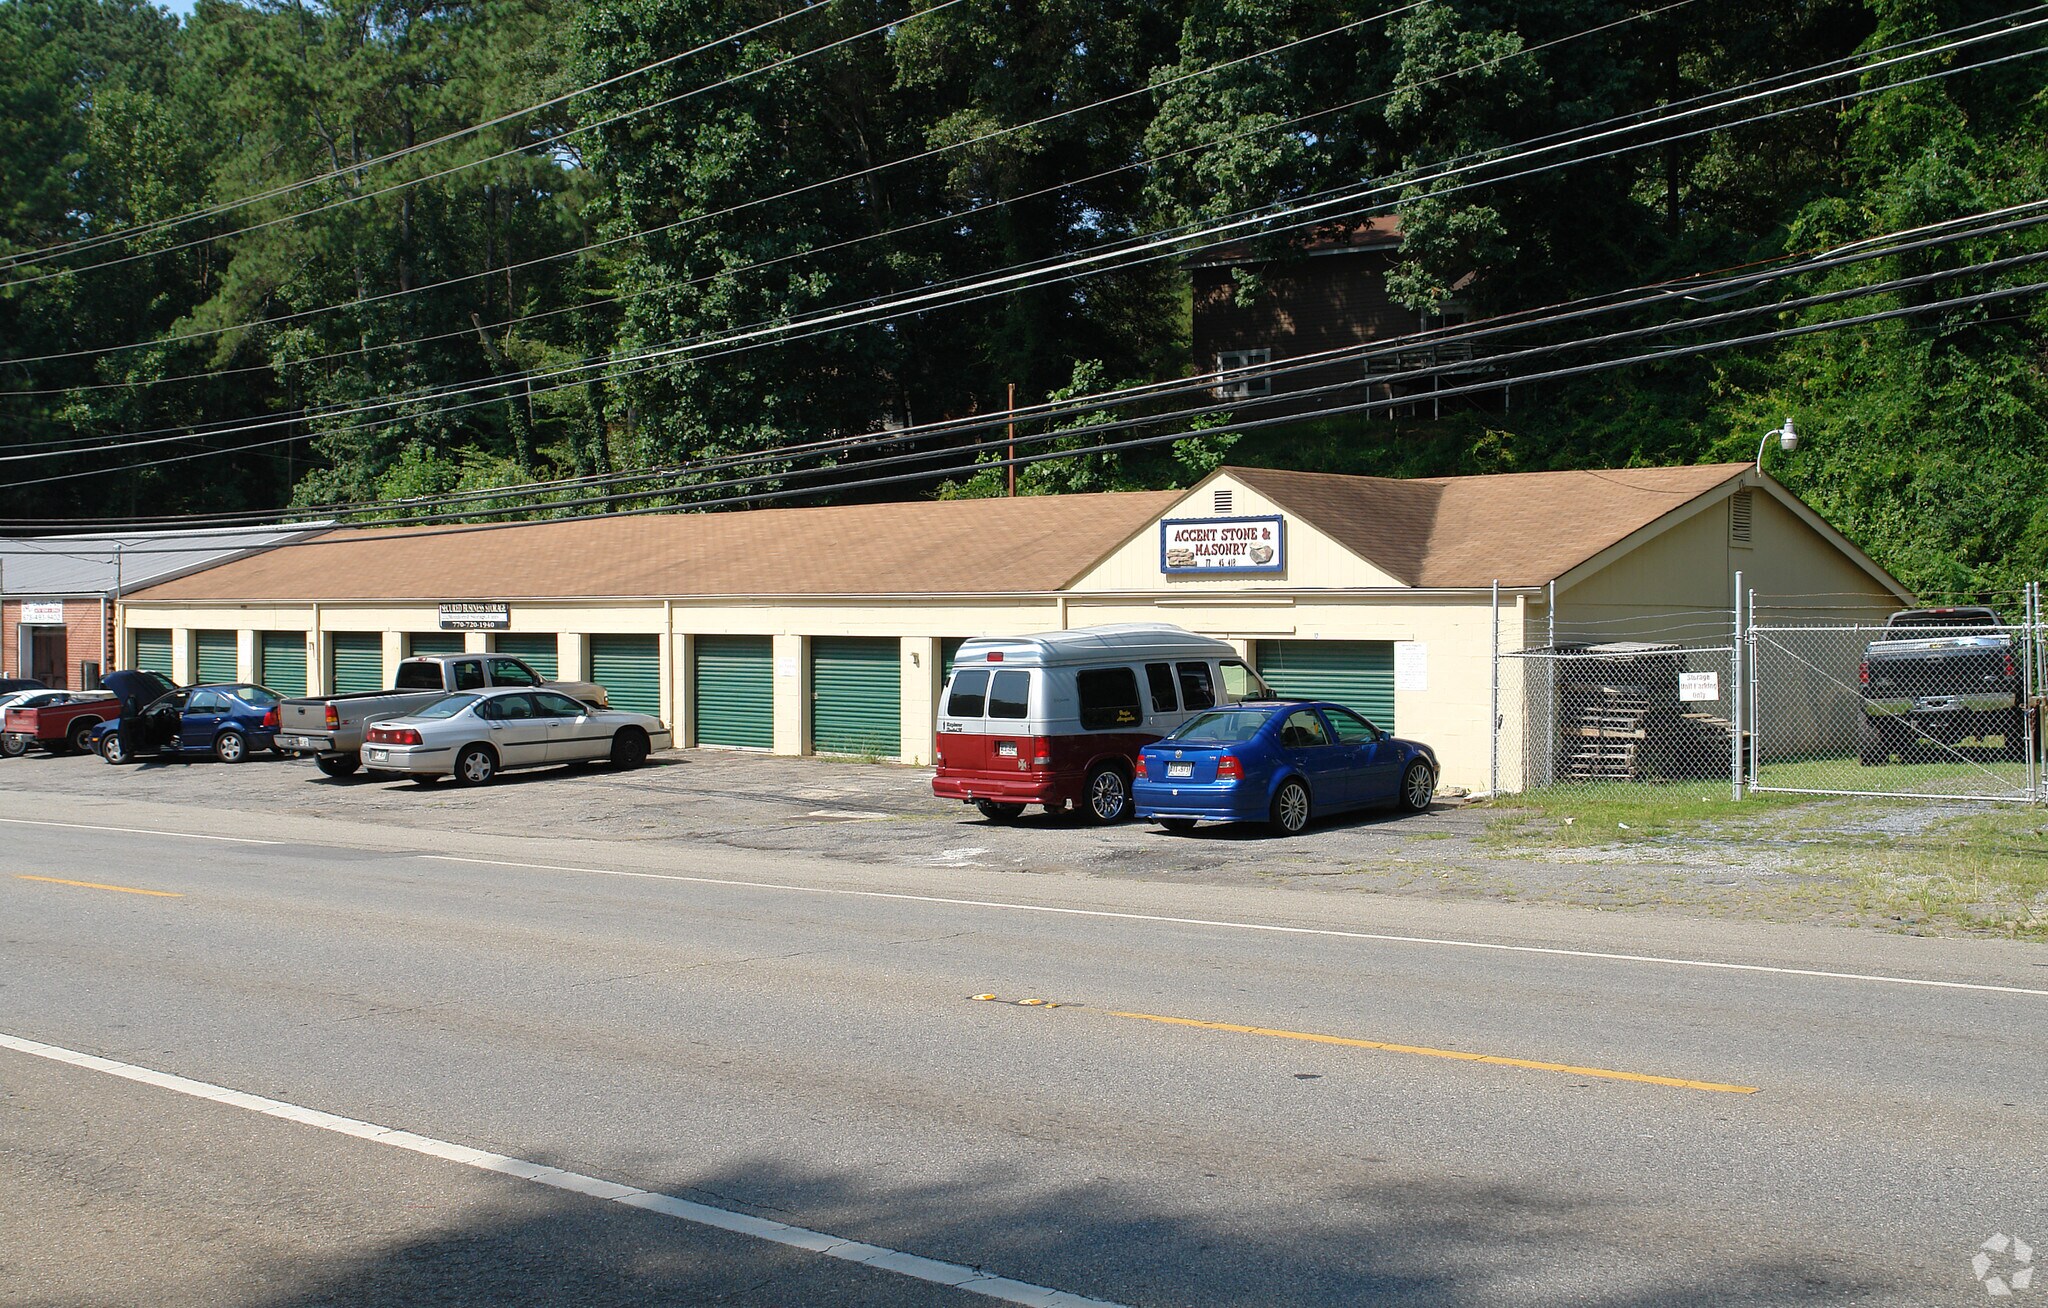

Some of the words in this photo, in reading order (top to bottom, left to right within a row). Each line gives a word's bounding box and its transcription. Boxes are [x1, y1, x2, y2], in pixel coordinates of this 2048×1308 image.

[1175, 529, 1217, 542] ACCENT
[1221, 528, 1258, 541] STONE
[1262, 527, 1271, 540] &
[1195, 543, 1248, 556] MASONRY
